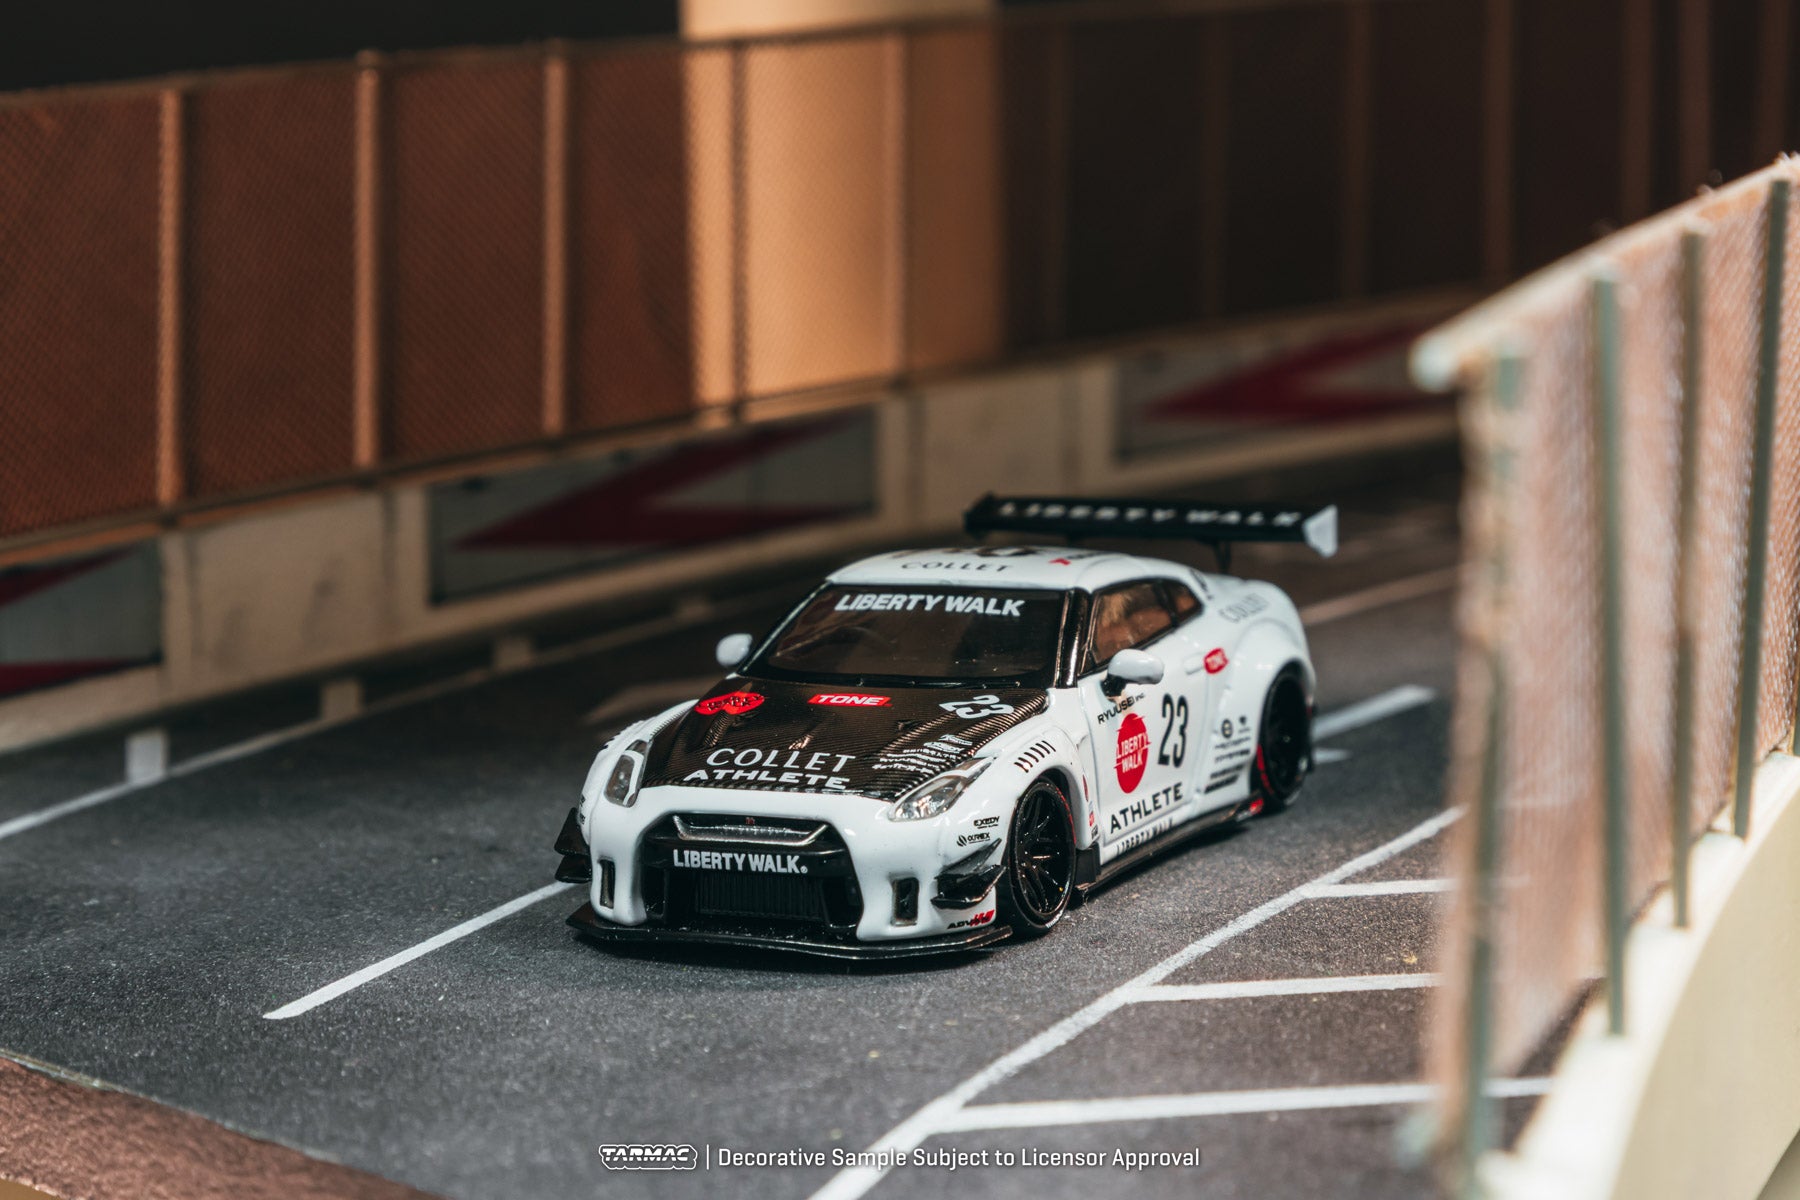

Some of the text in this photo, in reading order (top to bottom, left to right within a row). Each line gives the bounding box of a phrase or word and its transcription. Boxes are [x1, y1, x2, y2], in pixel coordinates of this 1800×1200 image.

[901, 561, 1012, 573] COLLET
[834, 594, 1025, 617] LIBERTY WALK
[817, 695, 882, 706] TONE
[939, 694, 1014, 719] 23
[1158, 693, 1189, 768] 23
[1116, 732, 1148, 759] LIBERTY
[706, 748, 855, 772] COLLET
[1121, 750, 1143, 773] WALK
[683, 769, 850, 790] ATHLETE
[1110, 782, 1183, 834] ATHLETE
[973, 815, 1000, 827] EXEDY
[673, 849, 745, 871] LIBERTY
